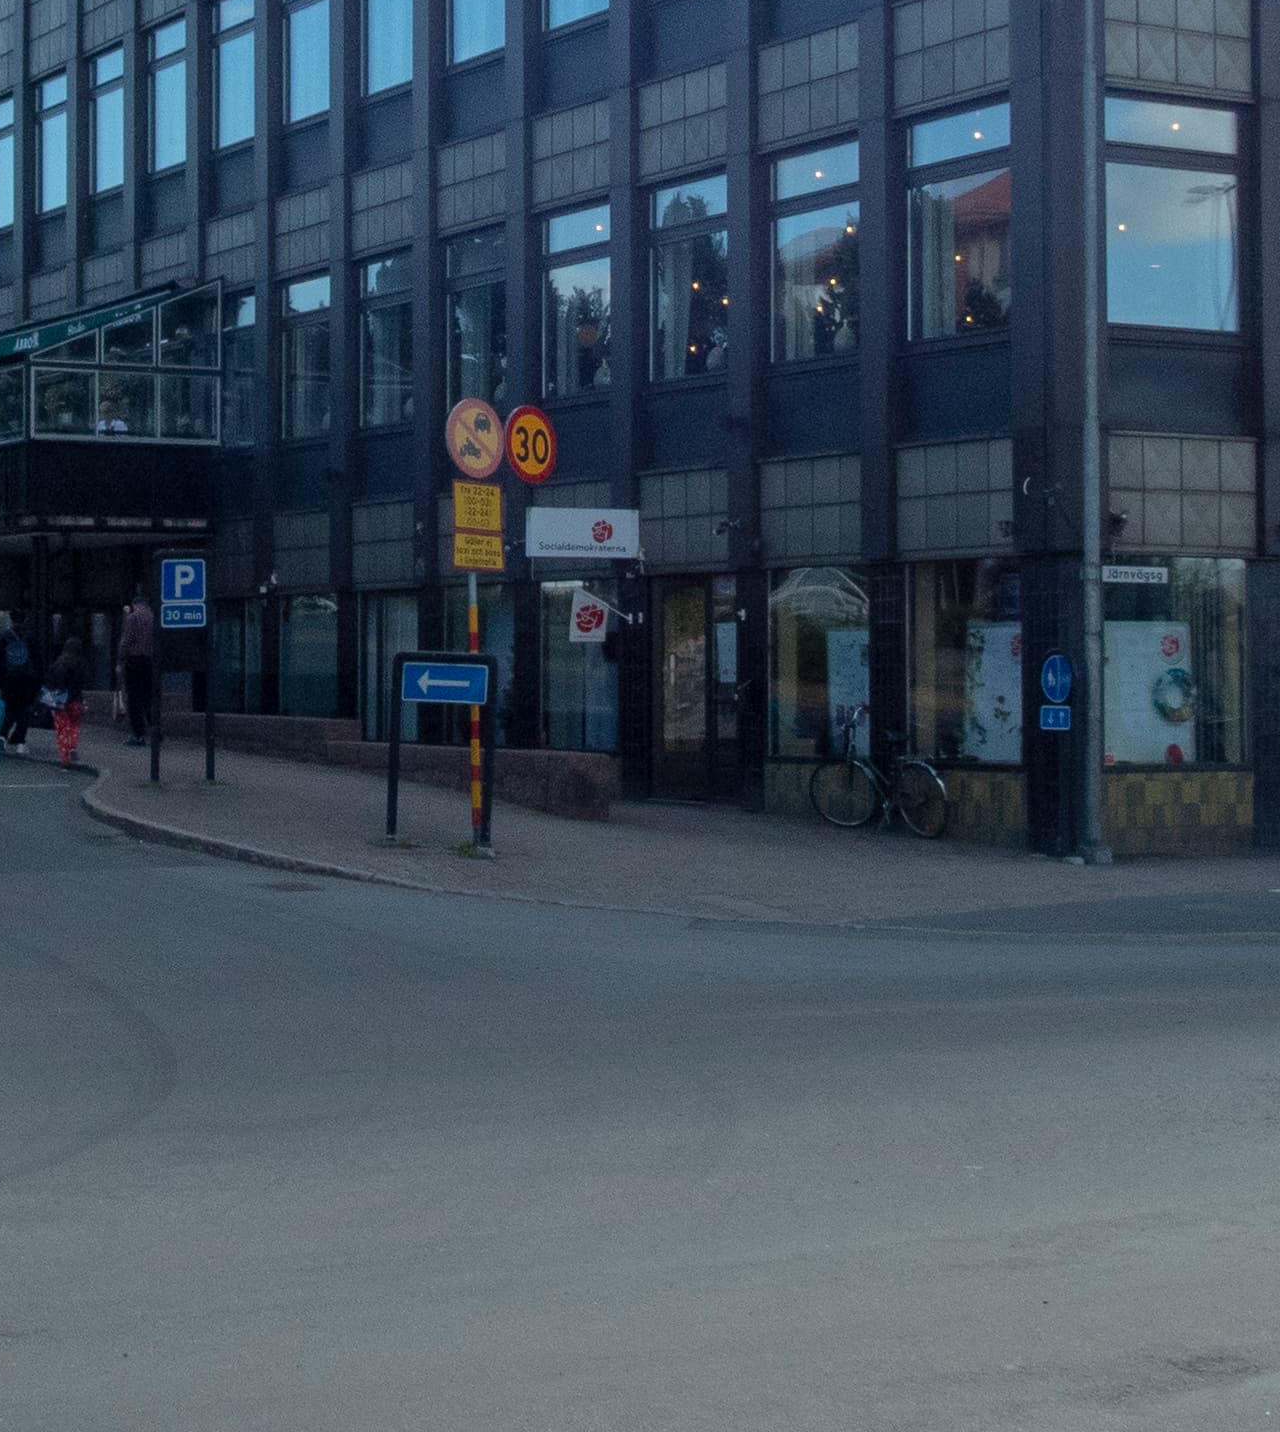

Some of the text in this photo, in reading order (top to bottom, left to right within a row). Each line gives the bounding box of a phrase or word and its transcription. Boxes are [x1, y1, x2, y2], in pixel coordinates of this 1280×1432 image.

[515, 425, 550, 465] 30
[538, 540, 627, 554] Socialdemokraterna
[174, 564, 195, 598] P
[1106, 568, 1163, 582] Järnvägsg
[165, 610, 202, 621] 30 min
